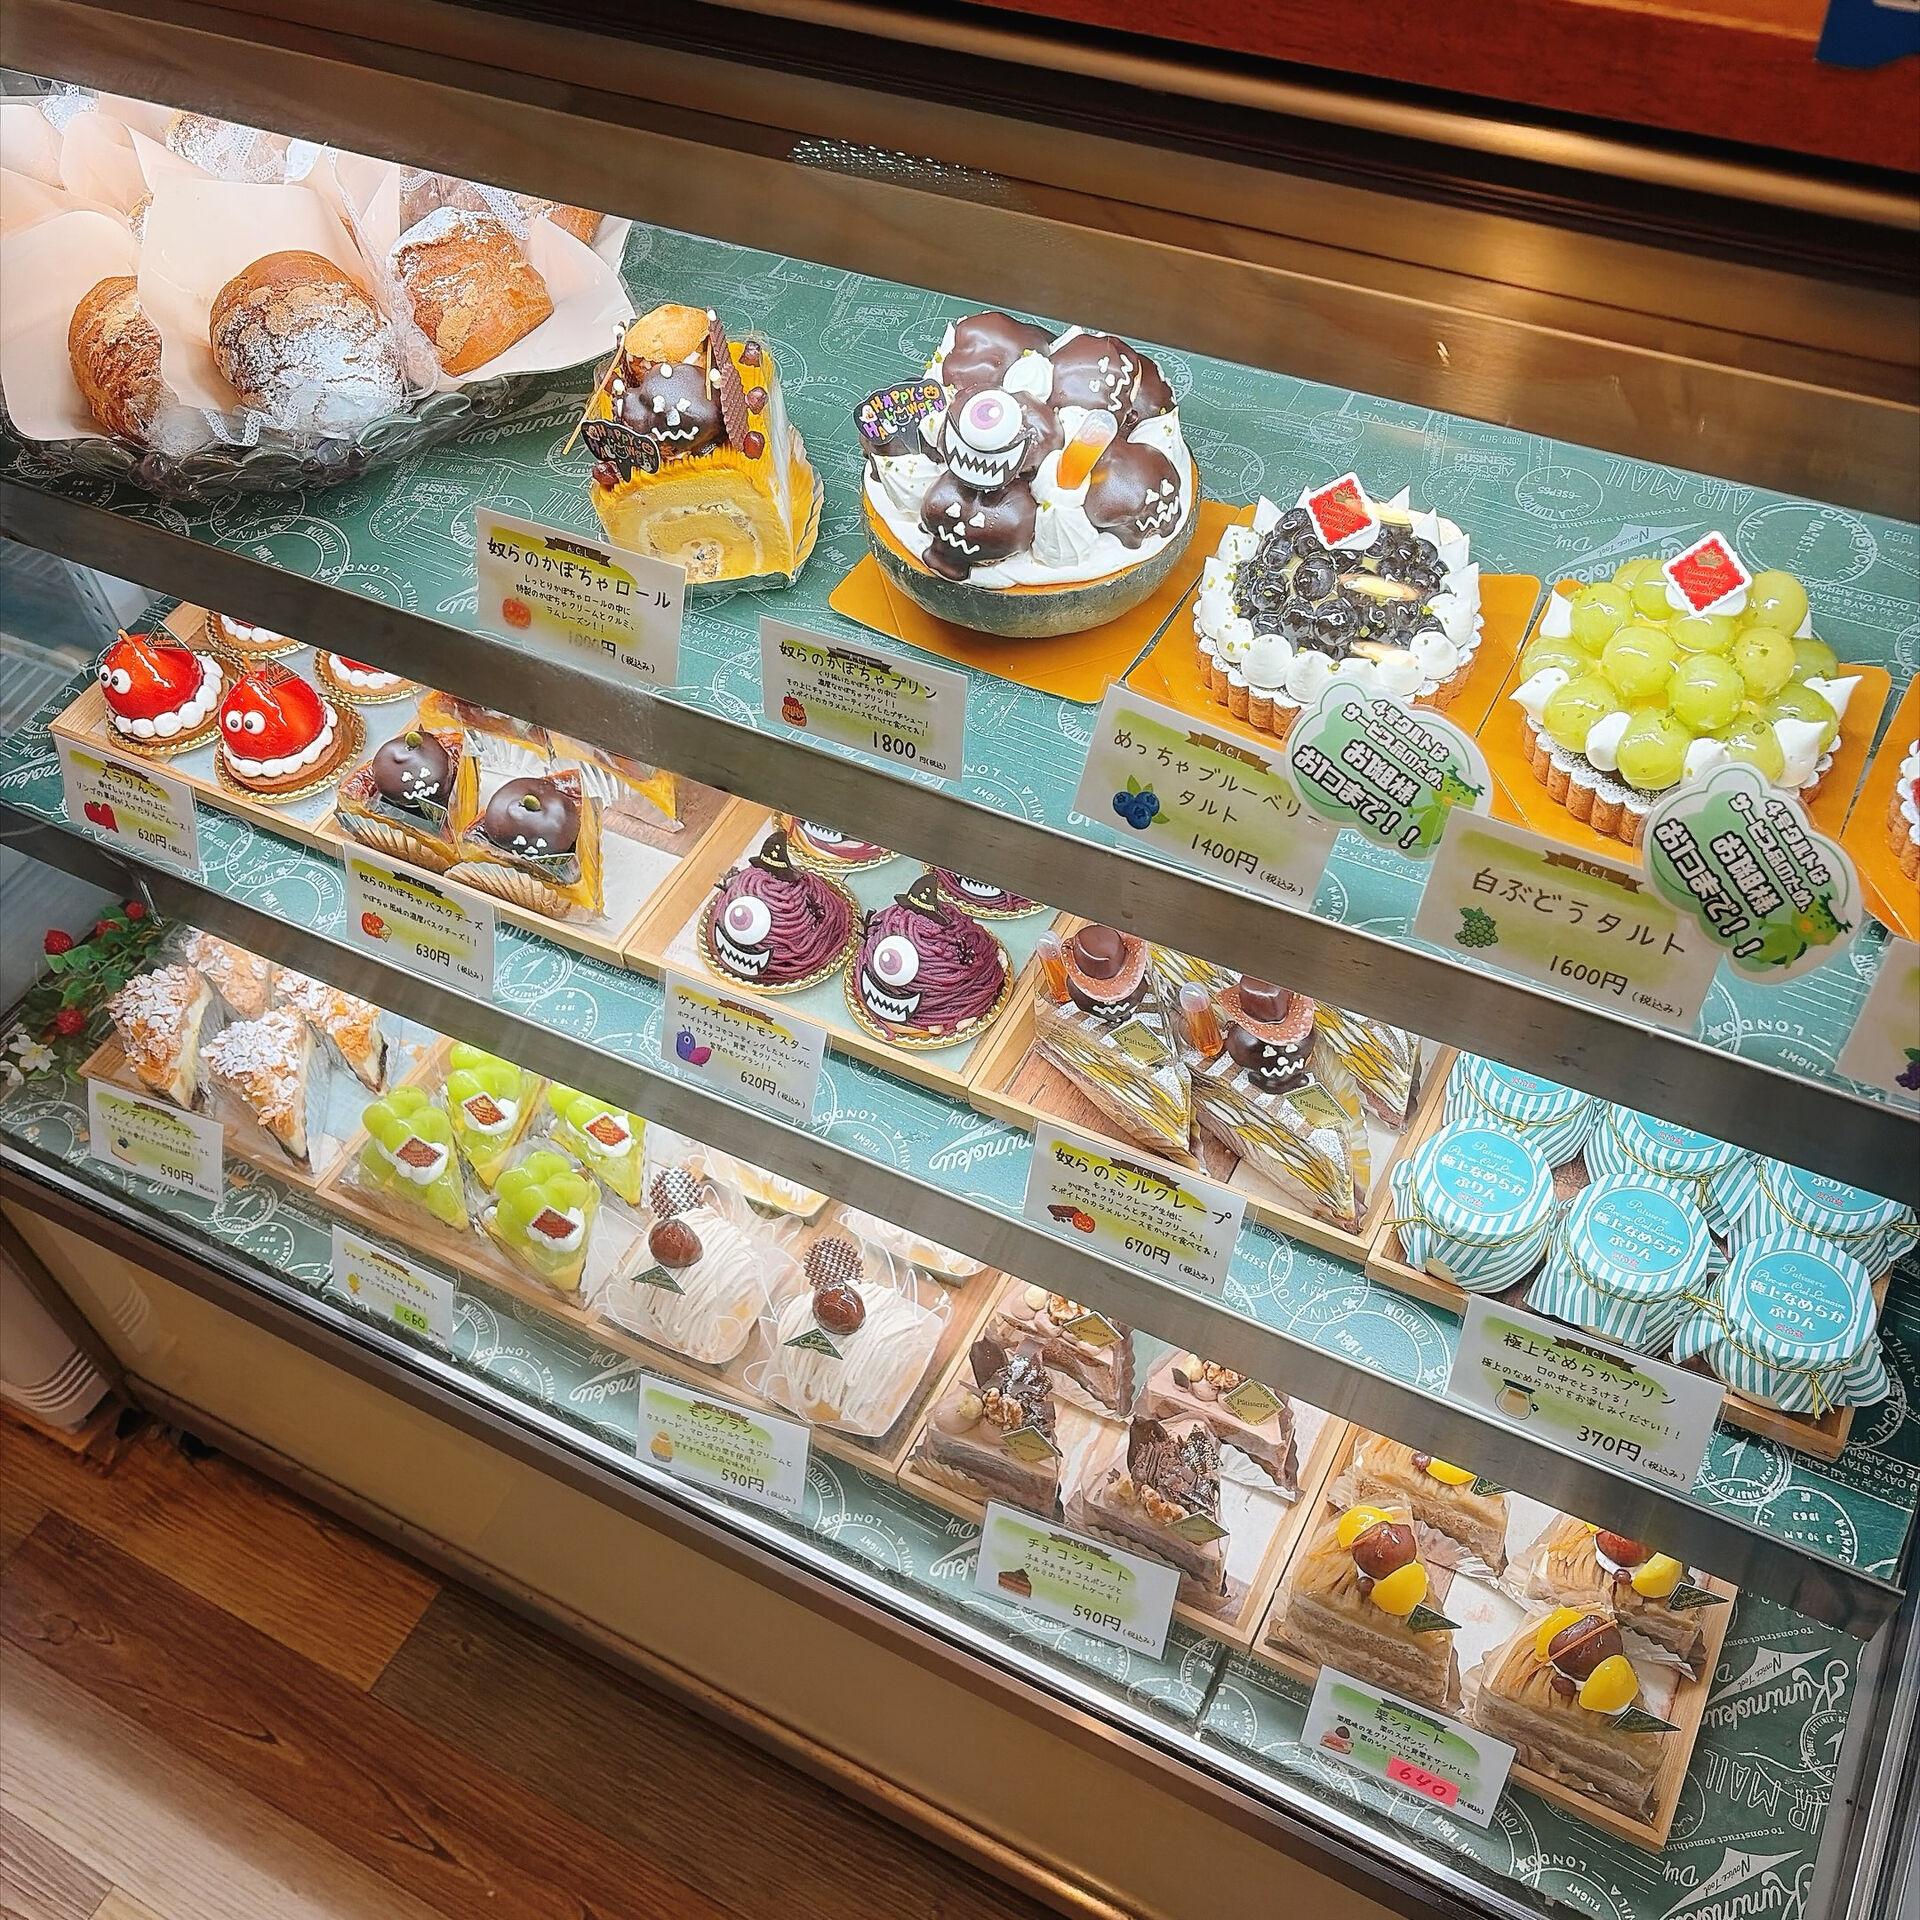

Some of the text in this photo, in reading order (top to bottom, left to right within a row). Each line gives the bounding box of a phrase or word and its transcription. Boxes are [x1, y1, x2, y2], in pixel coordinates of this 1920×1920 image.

[870, 387, 915, 413] HAPPY
[487, 535, 671, 611] 奴らのかぼちゃロール
[524, 574, 630, 615] しっとりかぼちゃロールの中に
[779, 639, 937, 703] 奴らのかぼちゃプリン
[872, 729, 915, 760] 1800
[1114, 729, 1322, 824] めっちゃブルーベリー
[1178, 790, 1237, 824] タルト
[137, 826, 167, 849] 620円
[1191, 834, 1259, 874] 1400円
[359, 871, 483, 931] 奴らのかぼちゃバスクチーズ
[1472, 867, 1685, 955] 白ぶどうタルト
[416, 940, 449, 967] 630円
[1549, 955, 1628, 996] 1600円
[677, 993, 811, 1055] ヴァイオレットモンスター
[740, 1068, 776, 1096] 620円
[160, 1162, 193, 1185] 590円
[1053, 1146, 1233, 1228] 奴らのミルクレープ
[1440, 1153, 1526, 1197] 極上なめらか
[1455, 1177, 1496, 1201] ぷりん
[1123, 1234, 1171, 1266] 670円
[1593, 1211, 1683, 1257] 極上なめらか
[1608, 1235, 1652, 1262] ぷりん
[1749, 1279, 1846, 1325] 極上なめらか
[1768, 1305, 1817, 1332] ぷりん
[1503, 1332, 1677, 1406] 極上なめらかプリン
[1537, 1366, 1629, 1407] 口の中でとろける！
[688, 1405, 752, 1435] モンブラン
[1577, 1425, 1642, 1463] 370円
[720, 1466, 764, 1494] 590円
[1026, 1535, 1129, 1584] チョコショート
[1072, 1602, 1121, 1633] 590円
[1373, 1706, 1446, 1748] 栗ショート
[1398, 1765, 1449, 1798] 640
